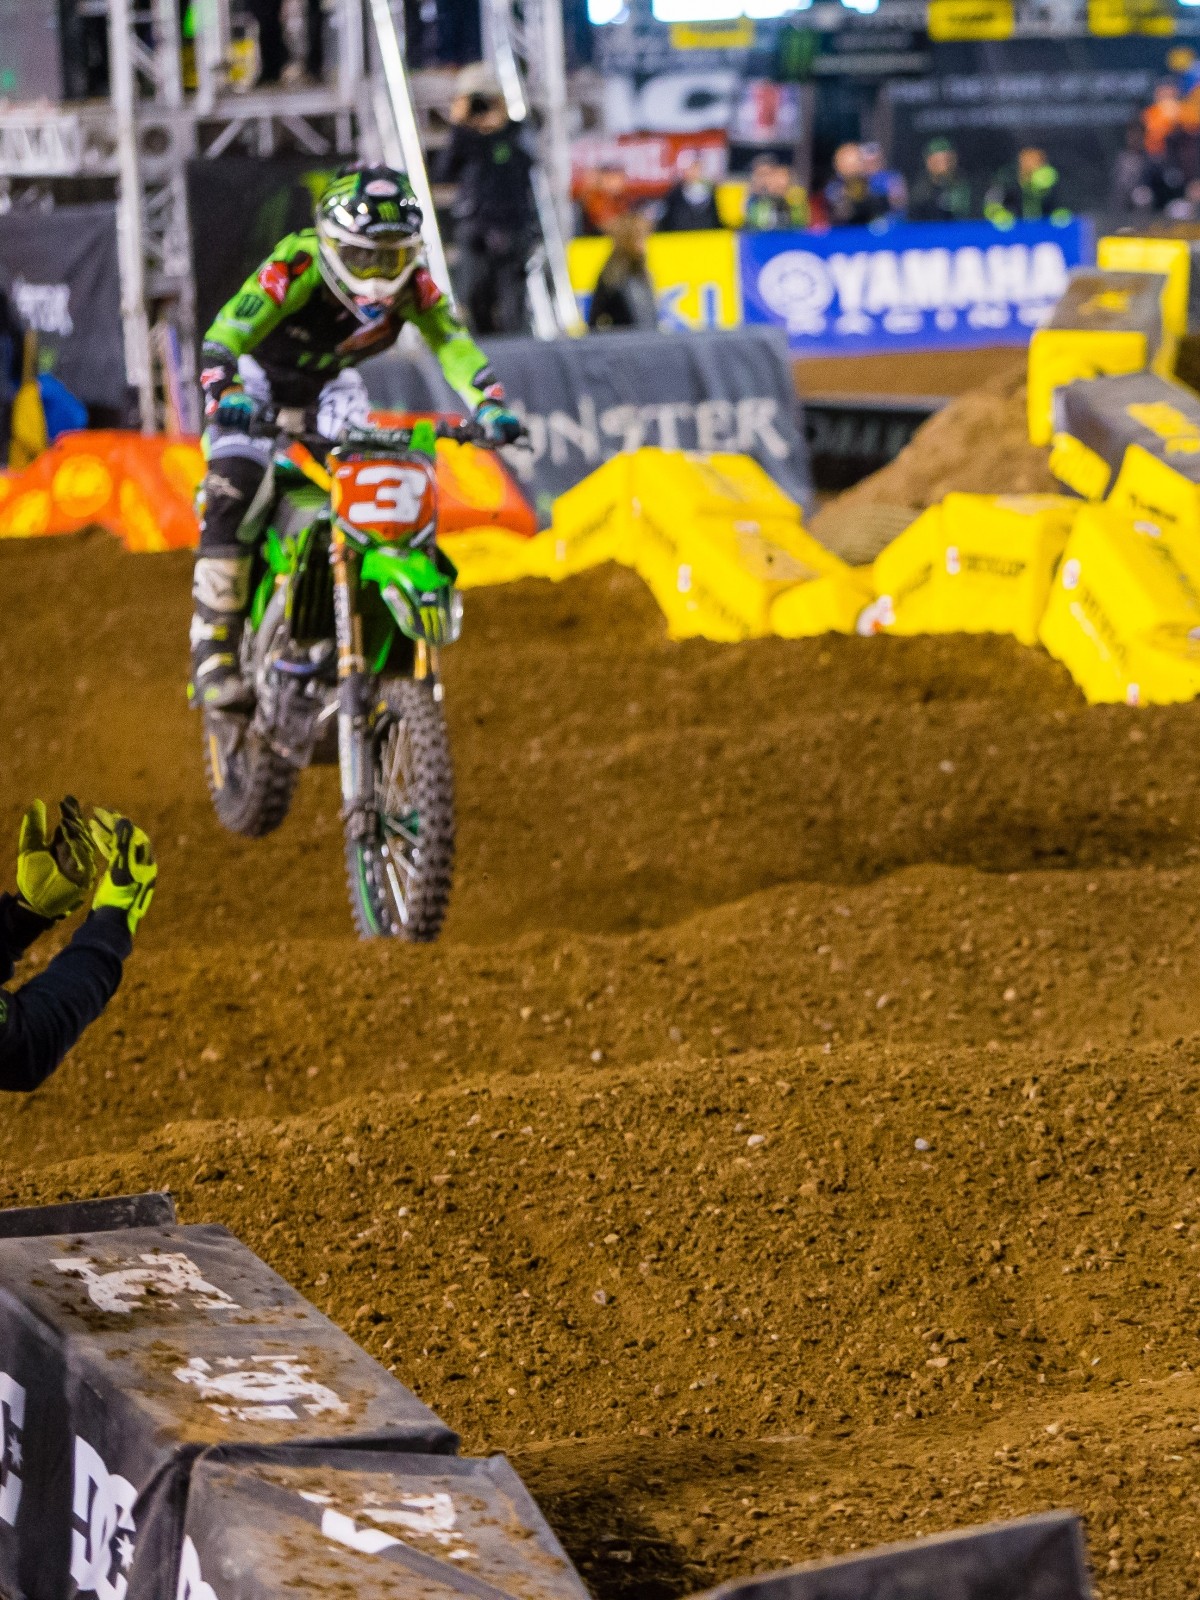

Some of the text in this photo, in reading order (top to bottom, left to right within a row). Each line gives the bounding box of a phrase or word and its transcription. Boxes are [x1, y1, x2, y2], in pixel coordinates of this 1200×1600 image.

[828, 242, 1071, 315] YAMAHA
[497, 396, 790, 480] ONSTER
[347, 466, 428, 524] 3
